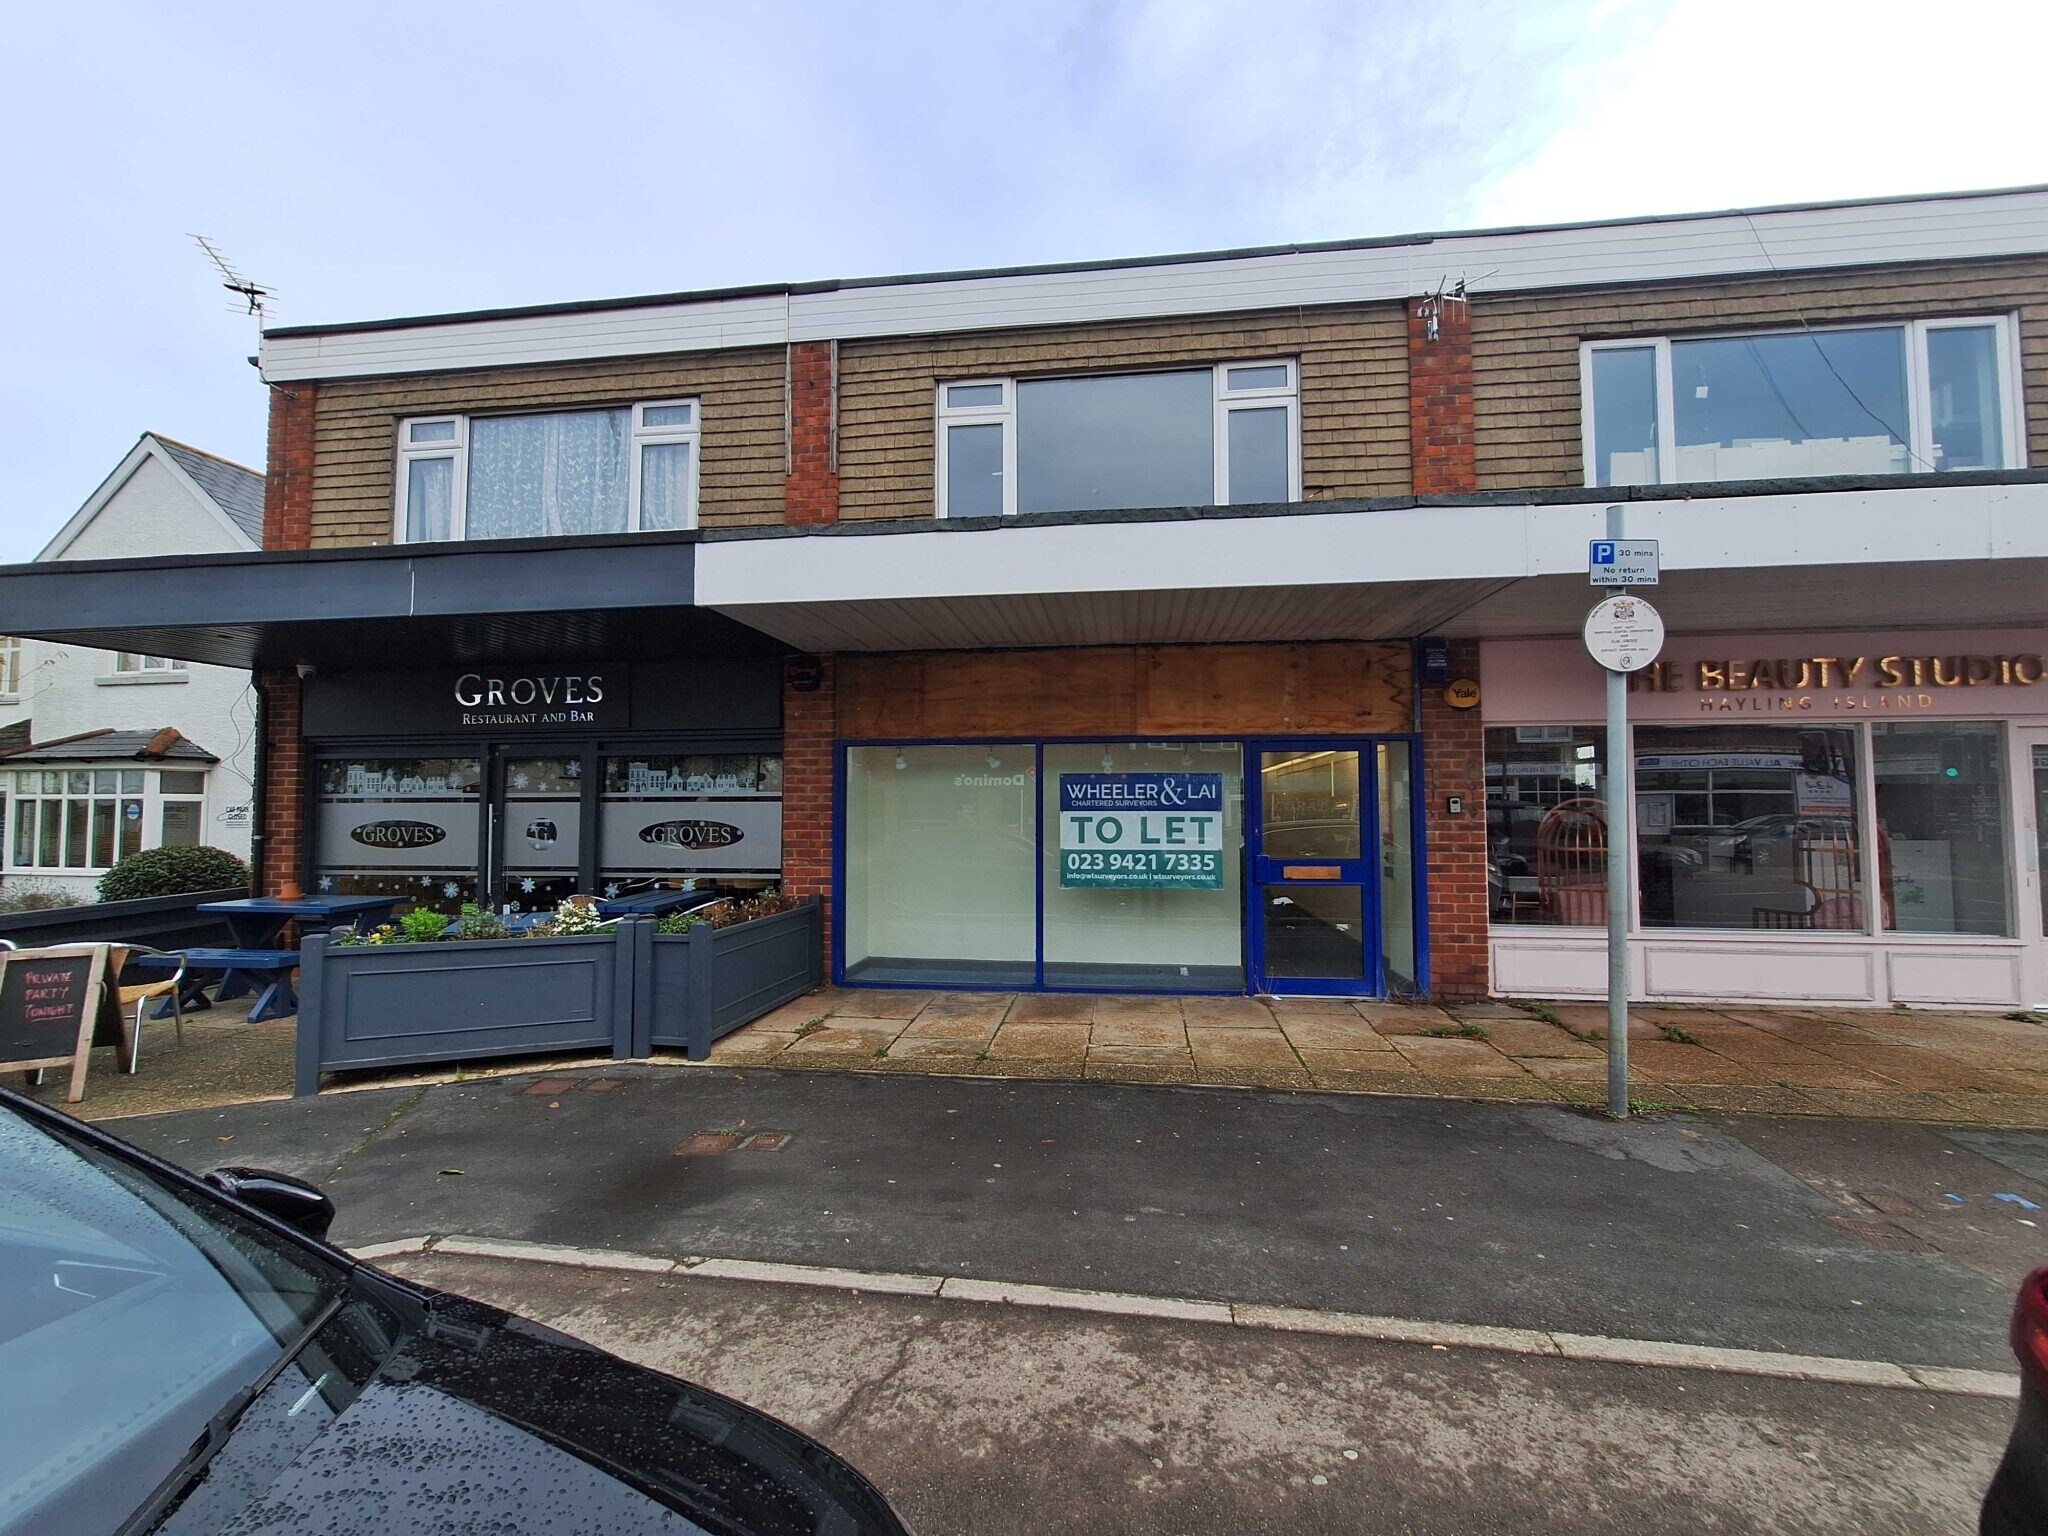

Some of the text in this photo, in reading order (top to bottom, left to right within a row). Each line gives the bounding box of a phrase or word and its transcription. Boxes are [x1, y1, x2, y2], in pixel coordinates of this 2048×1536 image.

[1597, 544, 1654, 563] P 30 mins
[1603, 566, 1616, 574] No
[1621, 575, 1634, 583] 30
[1637, 575, 1657, 583] mins
[1630, 654, 2048, 693] HE BEAUTY STUDIO
[454, 673, 604, 707] GROVES
[1453, 687, 1477, 699] Yale
[1700, 694, 1932, 712] HAYLING ISLAND
[1066, 777, 1216, 806] WHEELER & LAI
[362, 826, 435, 843] GROVES
[651, 825, 731, 844] GROVES
[1070, 816, 1213, 844] TO LET
[1067, 853, 1215, 870] 023 9421 7335
[1066, 872, 1148, 880] info@wlsurveyors.co.uk
[1152, 873, 1216, 881] wlsurveyors.co.uk
[25, 971, 73, 984] PRIVATE
[25, 986, 70, 1000] PARTY
[24, 1003, 74, 1019] TONIGHT
